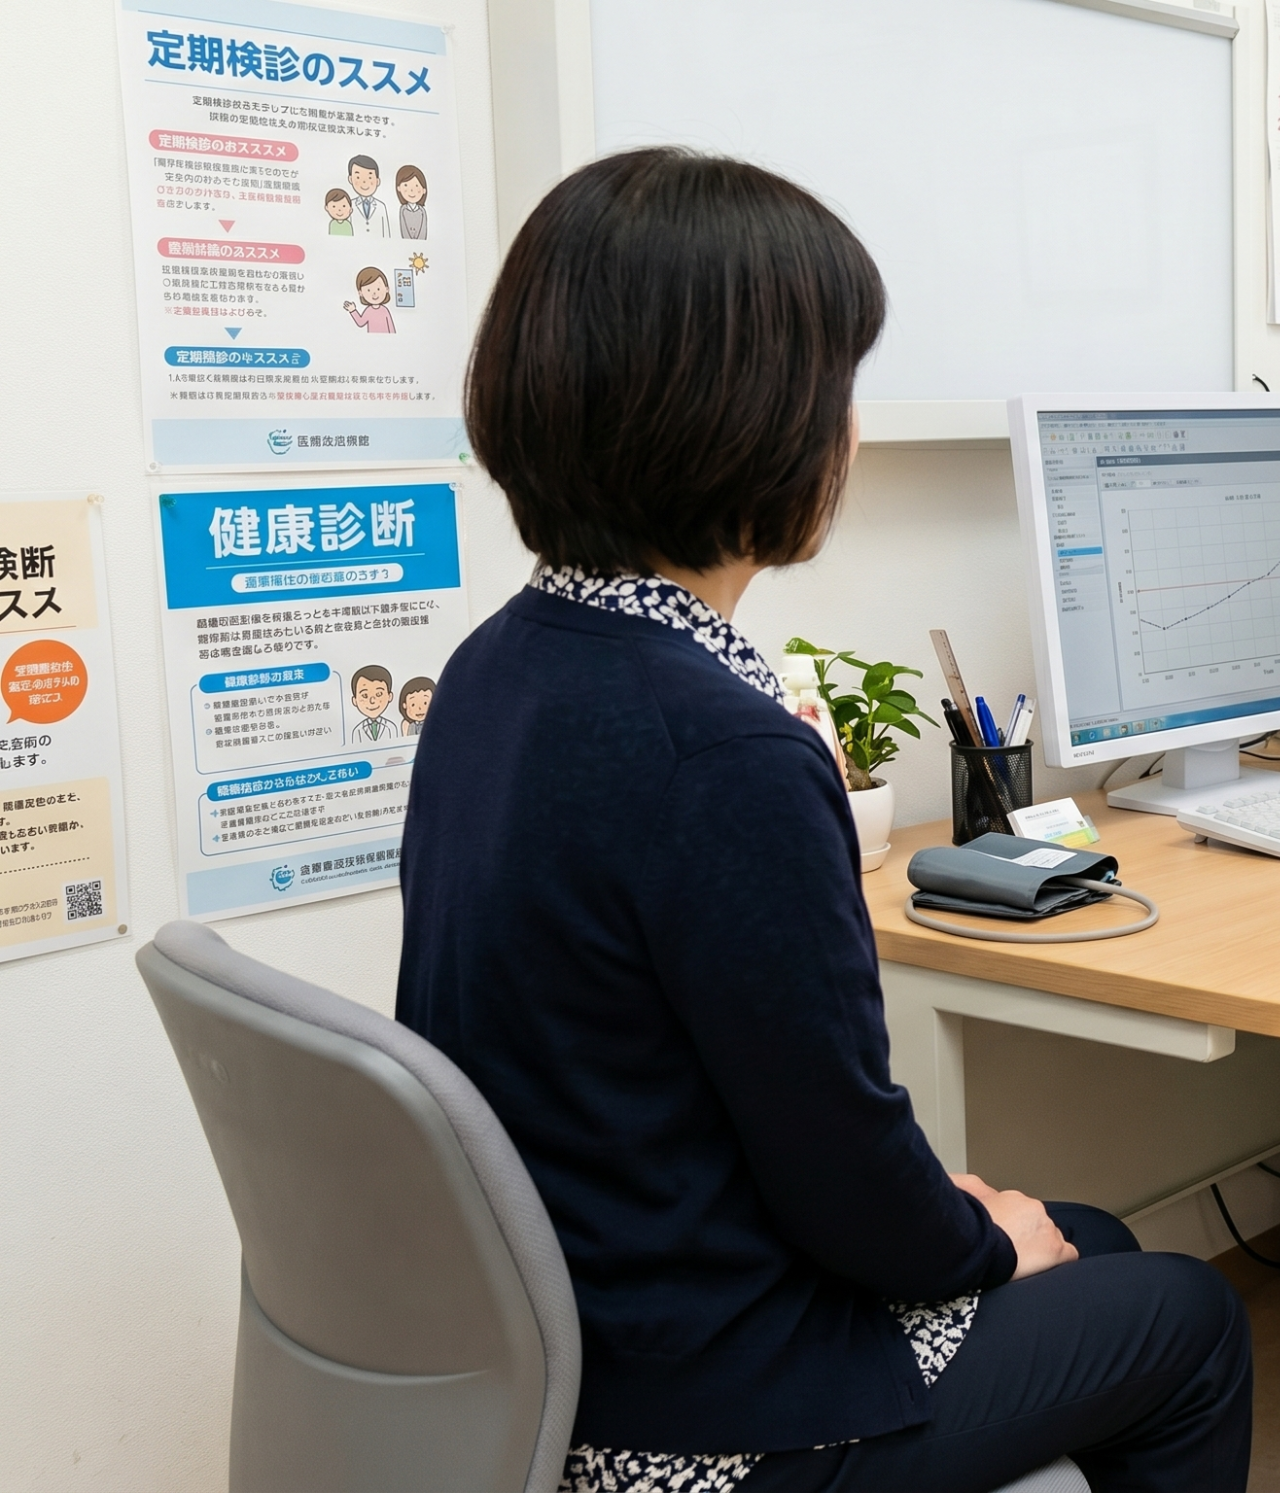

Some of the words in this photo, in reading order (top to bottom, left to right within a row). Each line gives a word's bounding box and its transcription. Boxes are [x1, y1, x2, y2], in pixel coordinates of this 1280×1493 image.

[147, 29, 432, 96] 定期検診のススメ
[208, 498, 416, 559] 健康診断
